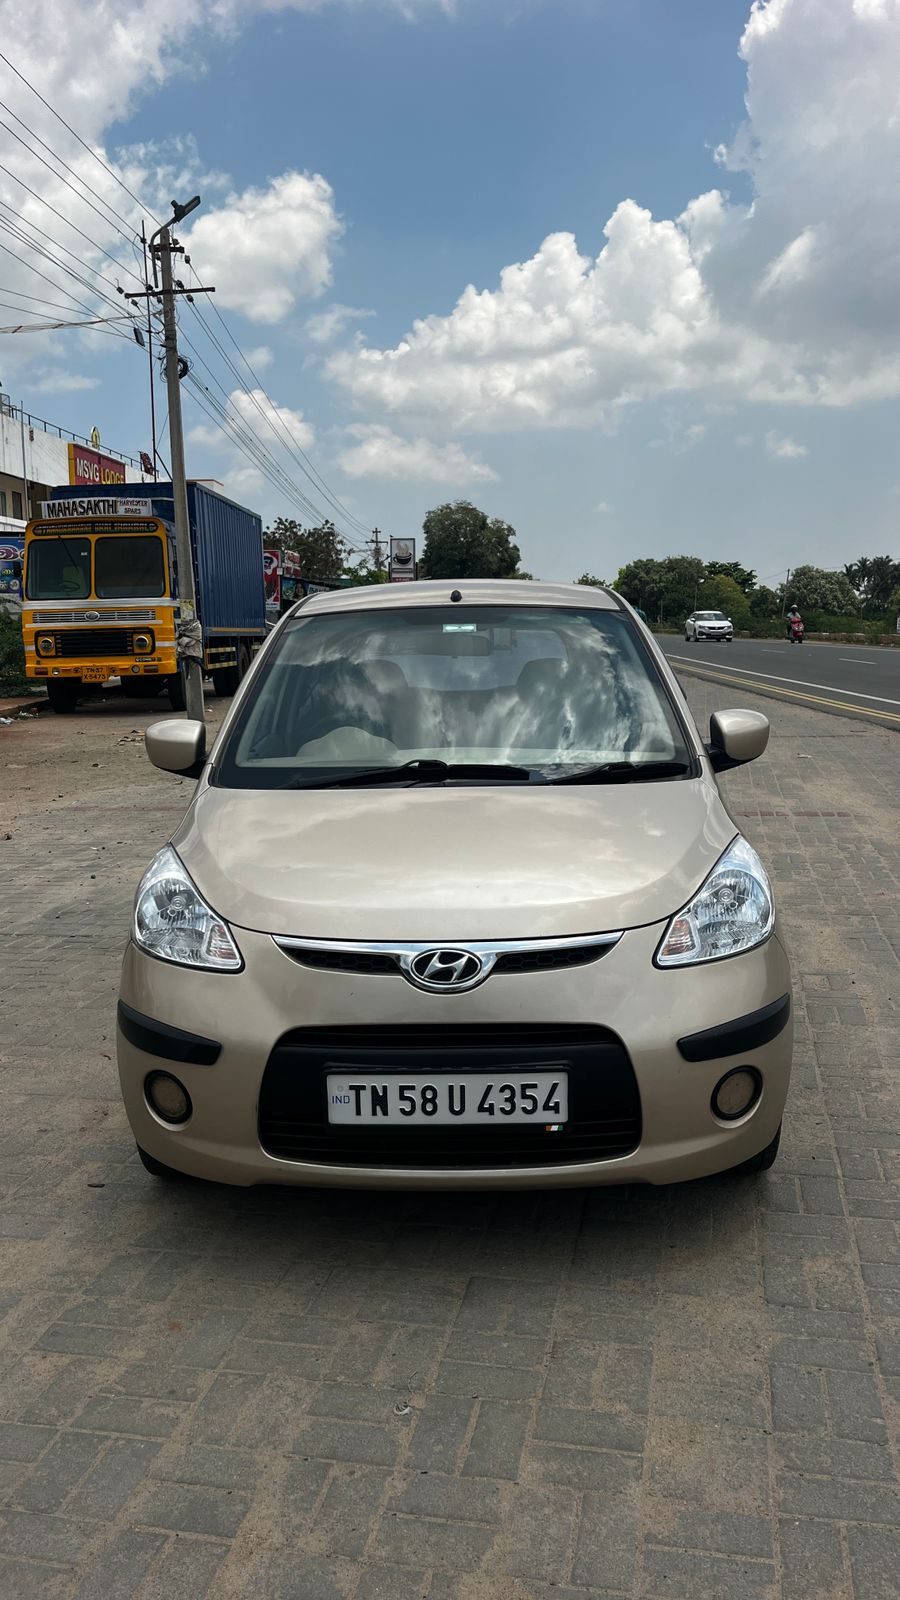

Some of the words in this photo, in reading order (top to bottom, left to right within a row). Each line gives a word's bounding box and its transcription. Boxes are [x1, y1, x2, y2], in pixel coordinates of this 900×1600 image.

[76, 457, 99, 482] MSVG
[47, 499, 117, 518] MAHASAKTHI
[332, 1095, 351, 1104] IND
[348, 1083, 388, 1117] TN
[398, 1083, 438, 1117] 58
[447, 1083, 465, 1116] U
[477, 1081, 560, 1116] 4354
